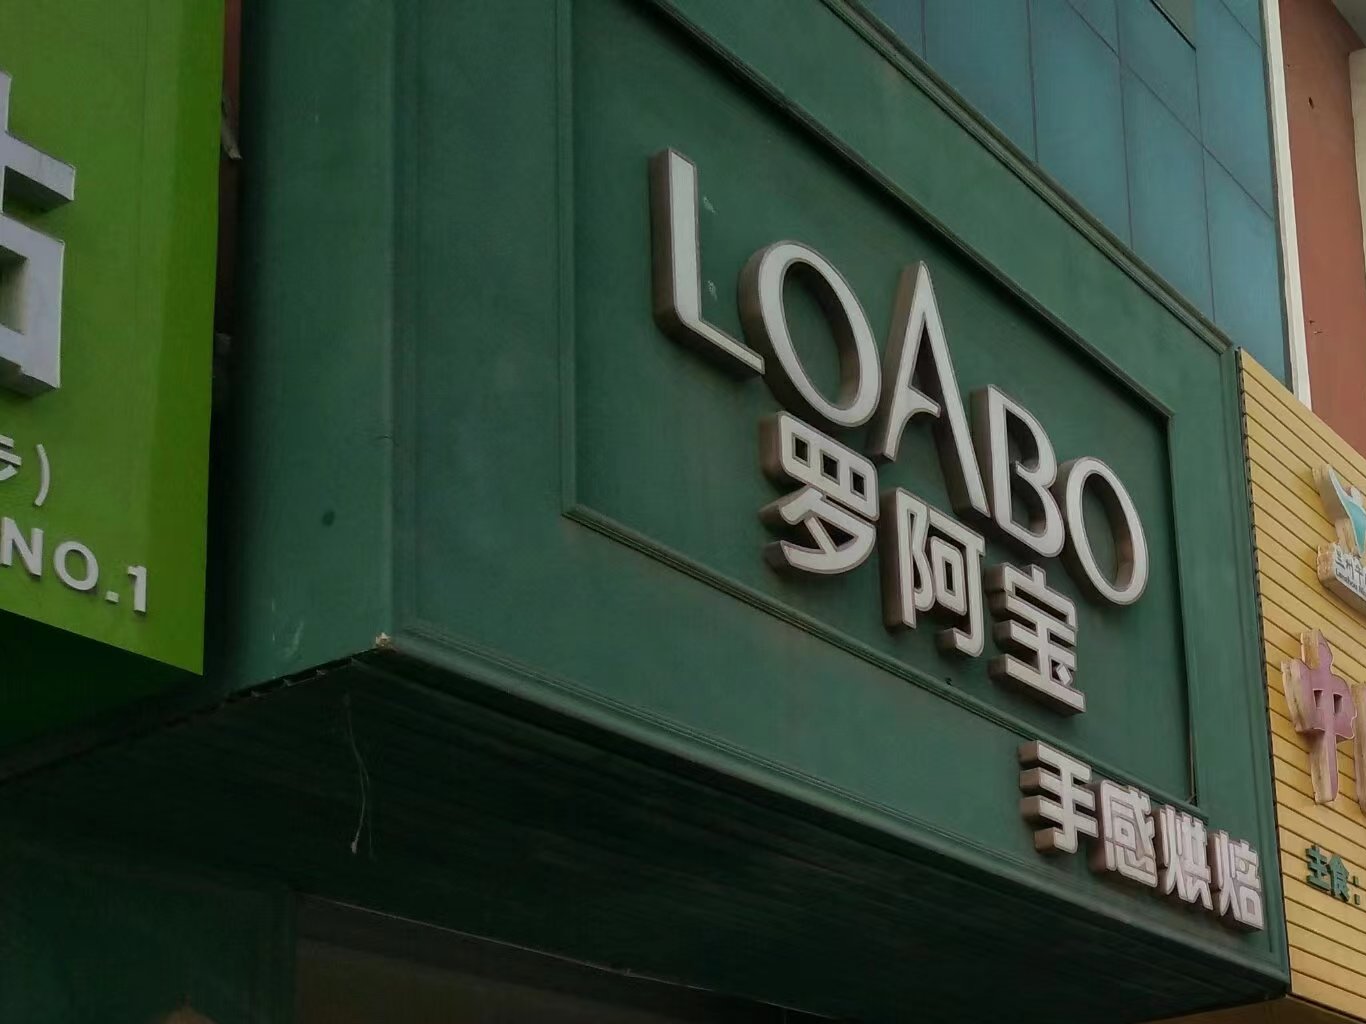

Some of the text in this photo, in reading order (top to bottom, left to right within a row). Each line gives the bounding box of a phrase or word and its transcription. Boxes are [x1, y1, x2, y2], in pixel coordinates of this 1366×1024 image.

[652, 147, 1148, 606] LOABO
[0, 516, 148, 615] NO.1
[759, 410, 1086, 716] 罗阿宝
[1019, 740, 1264, 932] 手感烘焙
